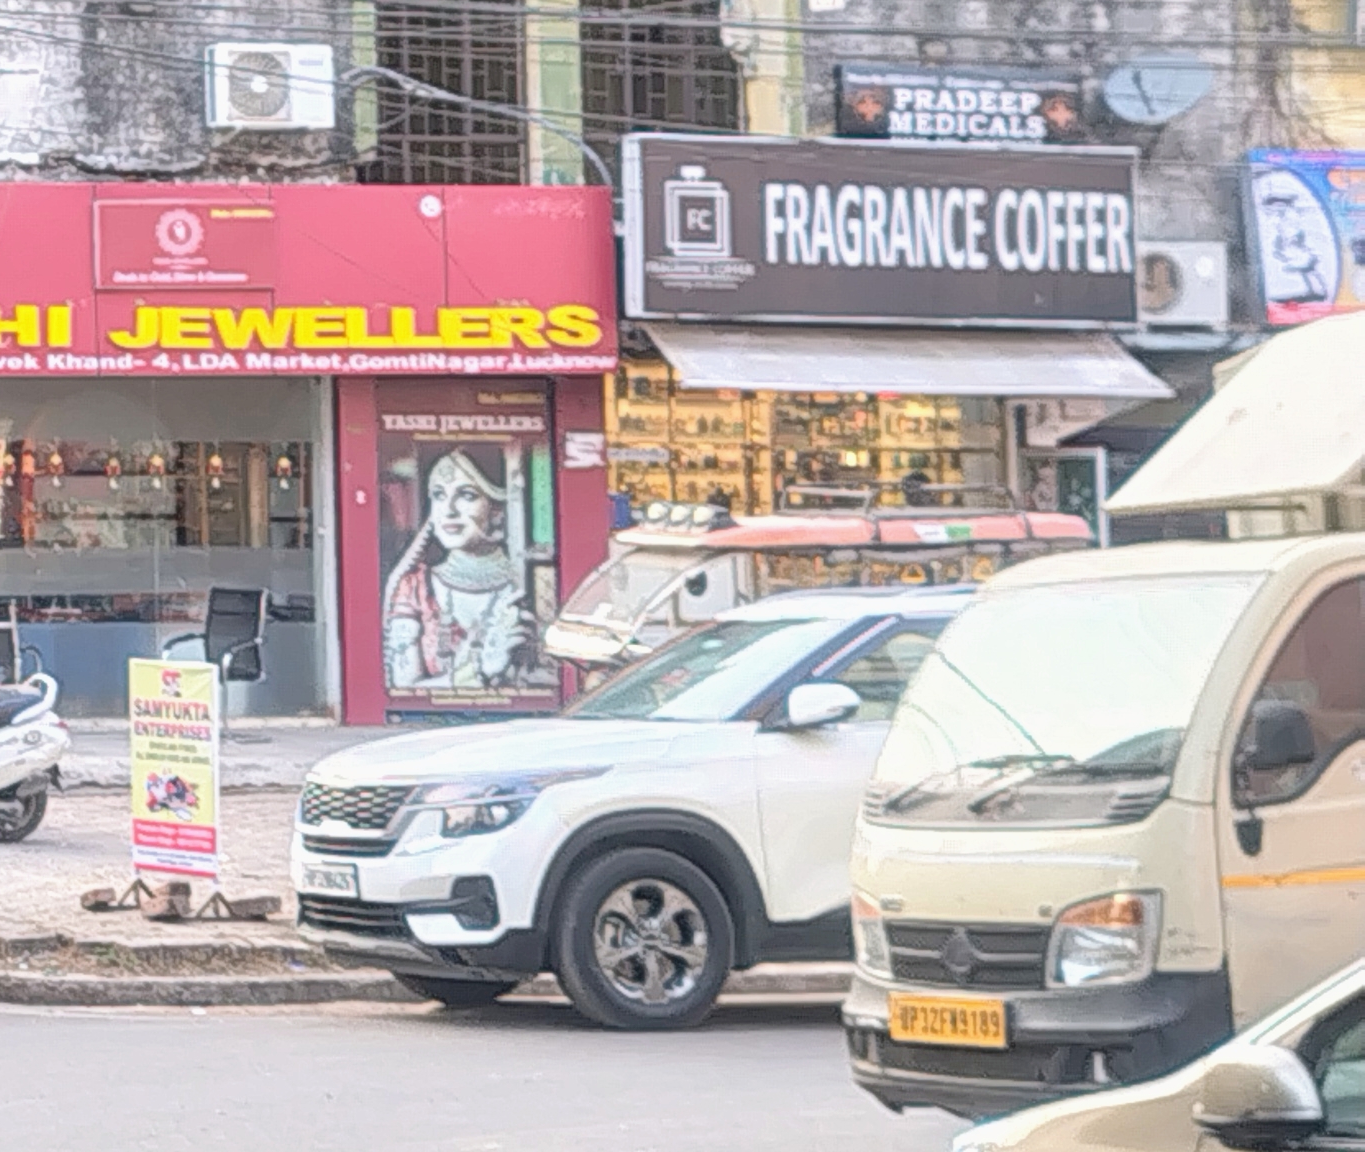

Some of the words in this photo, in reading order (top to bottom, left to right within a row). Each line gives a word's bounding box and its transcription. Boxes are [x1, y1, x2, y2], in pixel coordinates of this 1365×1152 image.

[891, 88, 1042, 115] PRADEEP
[887, 111, 1048, 139] MEDICALS
[686, 208, 713, 231] FC
[764, 183, 988, 270] FRAGRANCE
[994, 186, 1133, 274] COFFER
[107, 303, 604, 350] JEWELLERS
[46, 353, 146, 371] Khand-
[133, 698, 211, 722] SAMYUKTA
[133, 721, 212, 742] ENTERPRISES
